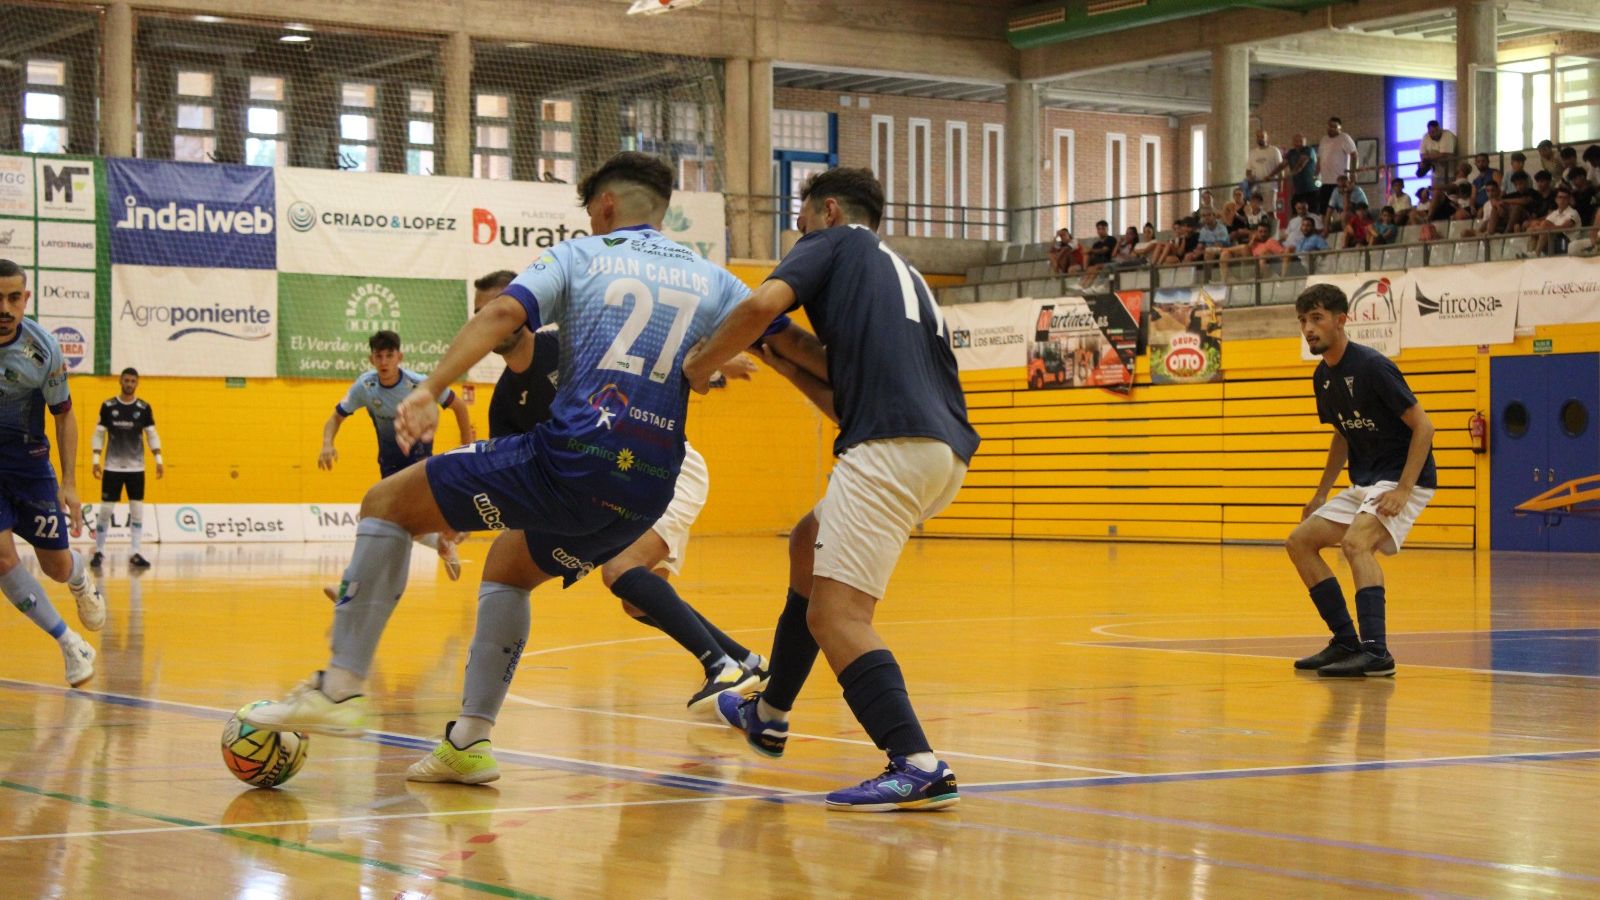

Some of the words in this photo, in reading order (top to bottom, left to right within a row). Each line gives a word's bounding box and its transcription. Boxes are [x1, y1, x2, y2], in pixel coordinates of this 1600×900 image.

[116, 195, 274, 235] indalweb
[588, 256, 640, 276] JUAN
[645, 262, 709, 297] CARLOS
[120, 299, 271, 327] Agroponiente
[1439, 292, 1495, 314] fircosa
[595, 277, 702, 385] 27
[307, 336, 349, 352] Verde
[1169, 354, 1201, 370] OTTO
[567, 438, 617, 461] Ramiro
[34, 515, 60, 539] 22
